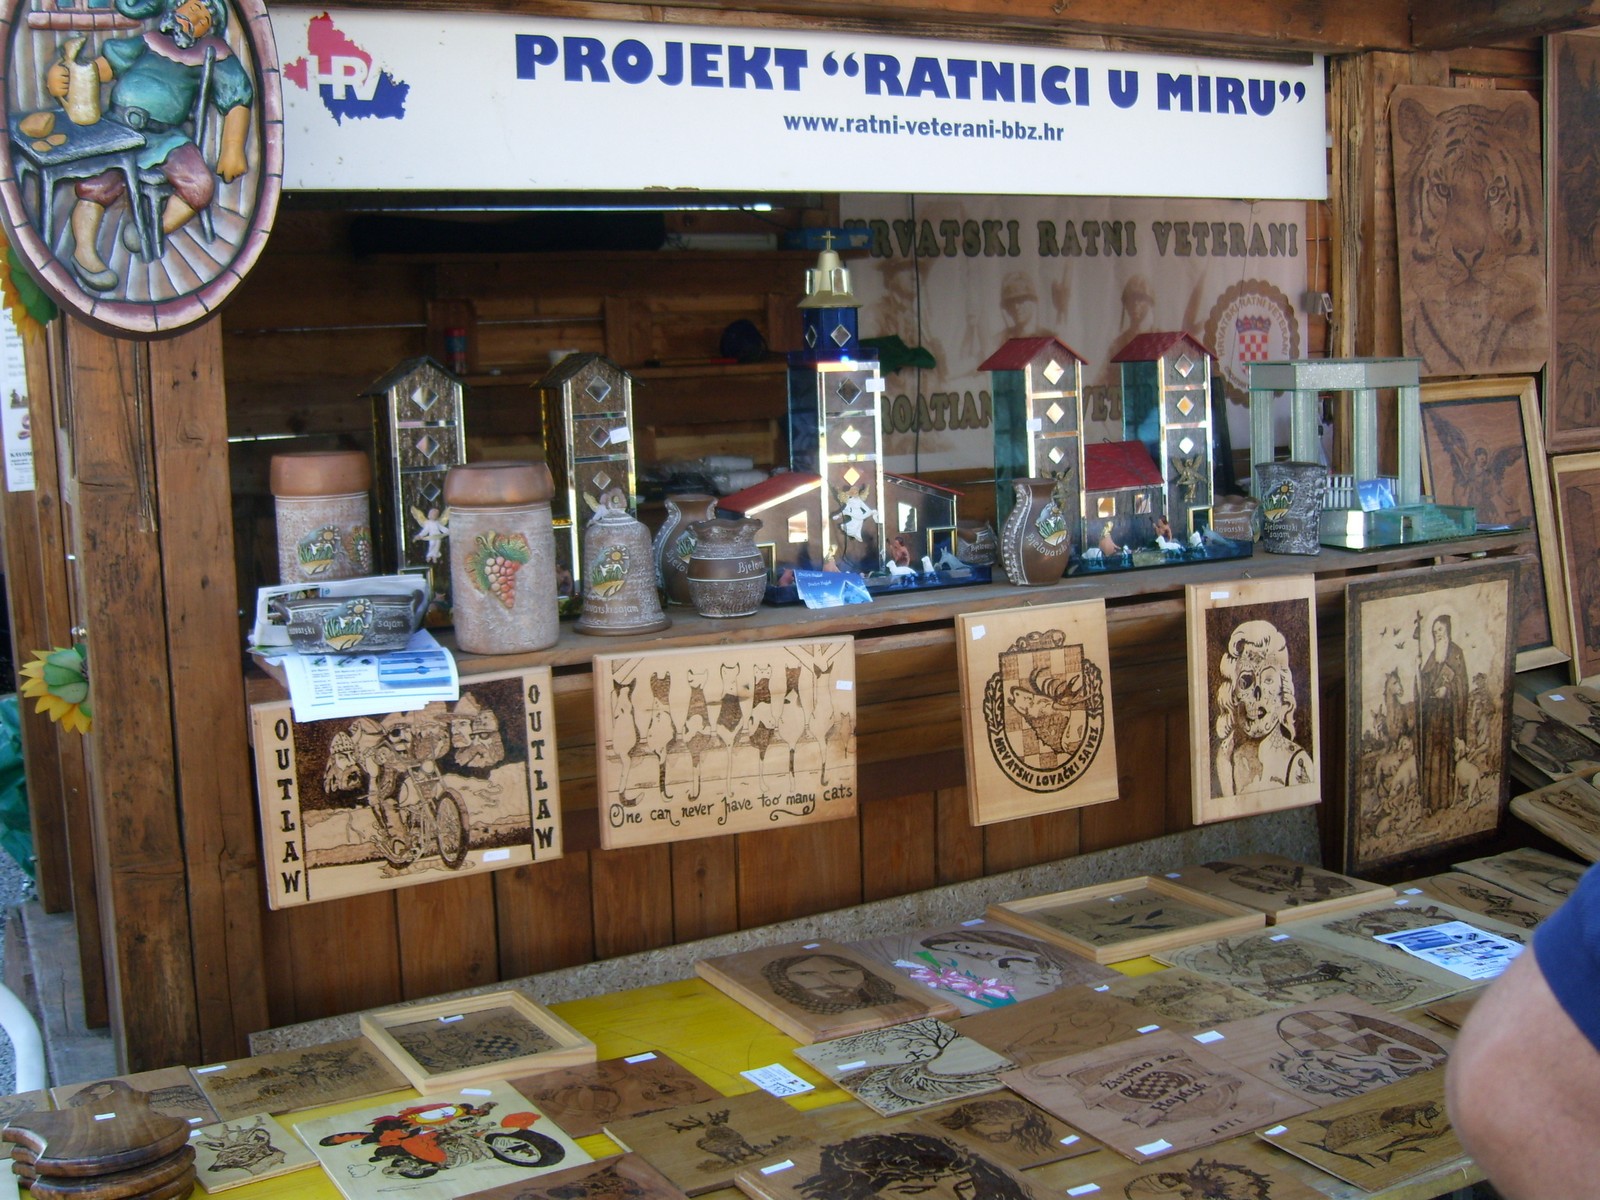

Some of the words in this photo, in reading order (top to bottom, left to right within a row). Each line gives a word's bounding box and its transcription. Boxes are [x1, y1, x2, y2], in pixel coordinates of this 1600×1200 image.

[515, 33, 808, 91] PROJEKT
[822, 50, 1089, 106] “RATNICI
[1108, 70, 1139, 109] U
[1156, 72, 1306, 117] MIRU”
[783, 114, 1064, 142] www.ratni-veterani-bbz.hr
[843, 219, 1021, 259] RVATSKI
[1037, 219, 1137, 258] RATNI
[1152, 221, 1299, 258] VETERANI
[528, 684, 554, 849] OUTLAW
[993, 737, 1034, 784] HRVATSKI
[1035, 761, 1080, 787] LOVAČKI
[1077, 726, 1099, 765] SAVEZ
[275, 718, 301, 894] OUTLAW
[609, 803, 643, 829] One
[650, 808, 681, 827] can
[681, 803, 715, 818] never
[717, 796, 753, 825] have
[757, 793, 782, 808] too
[823, 784, 853, 802] cats
